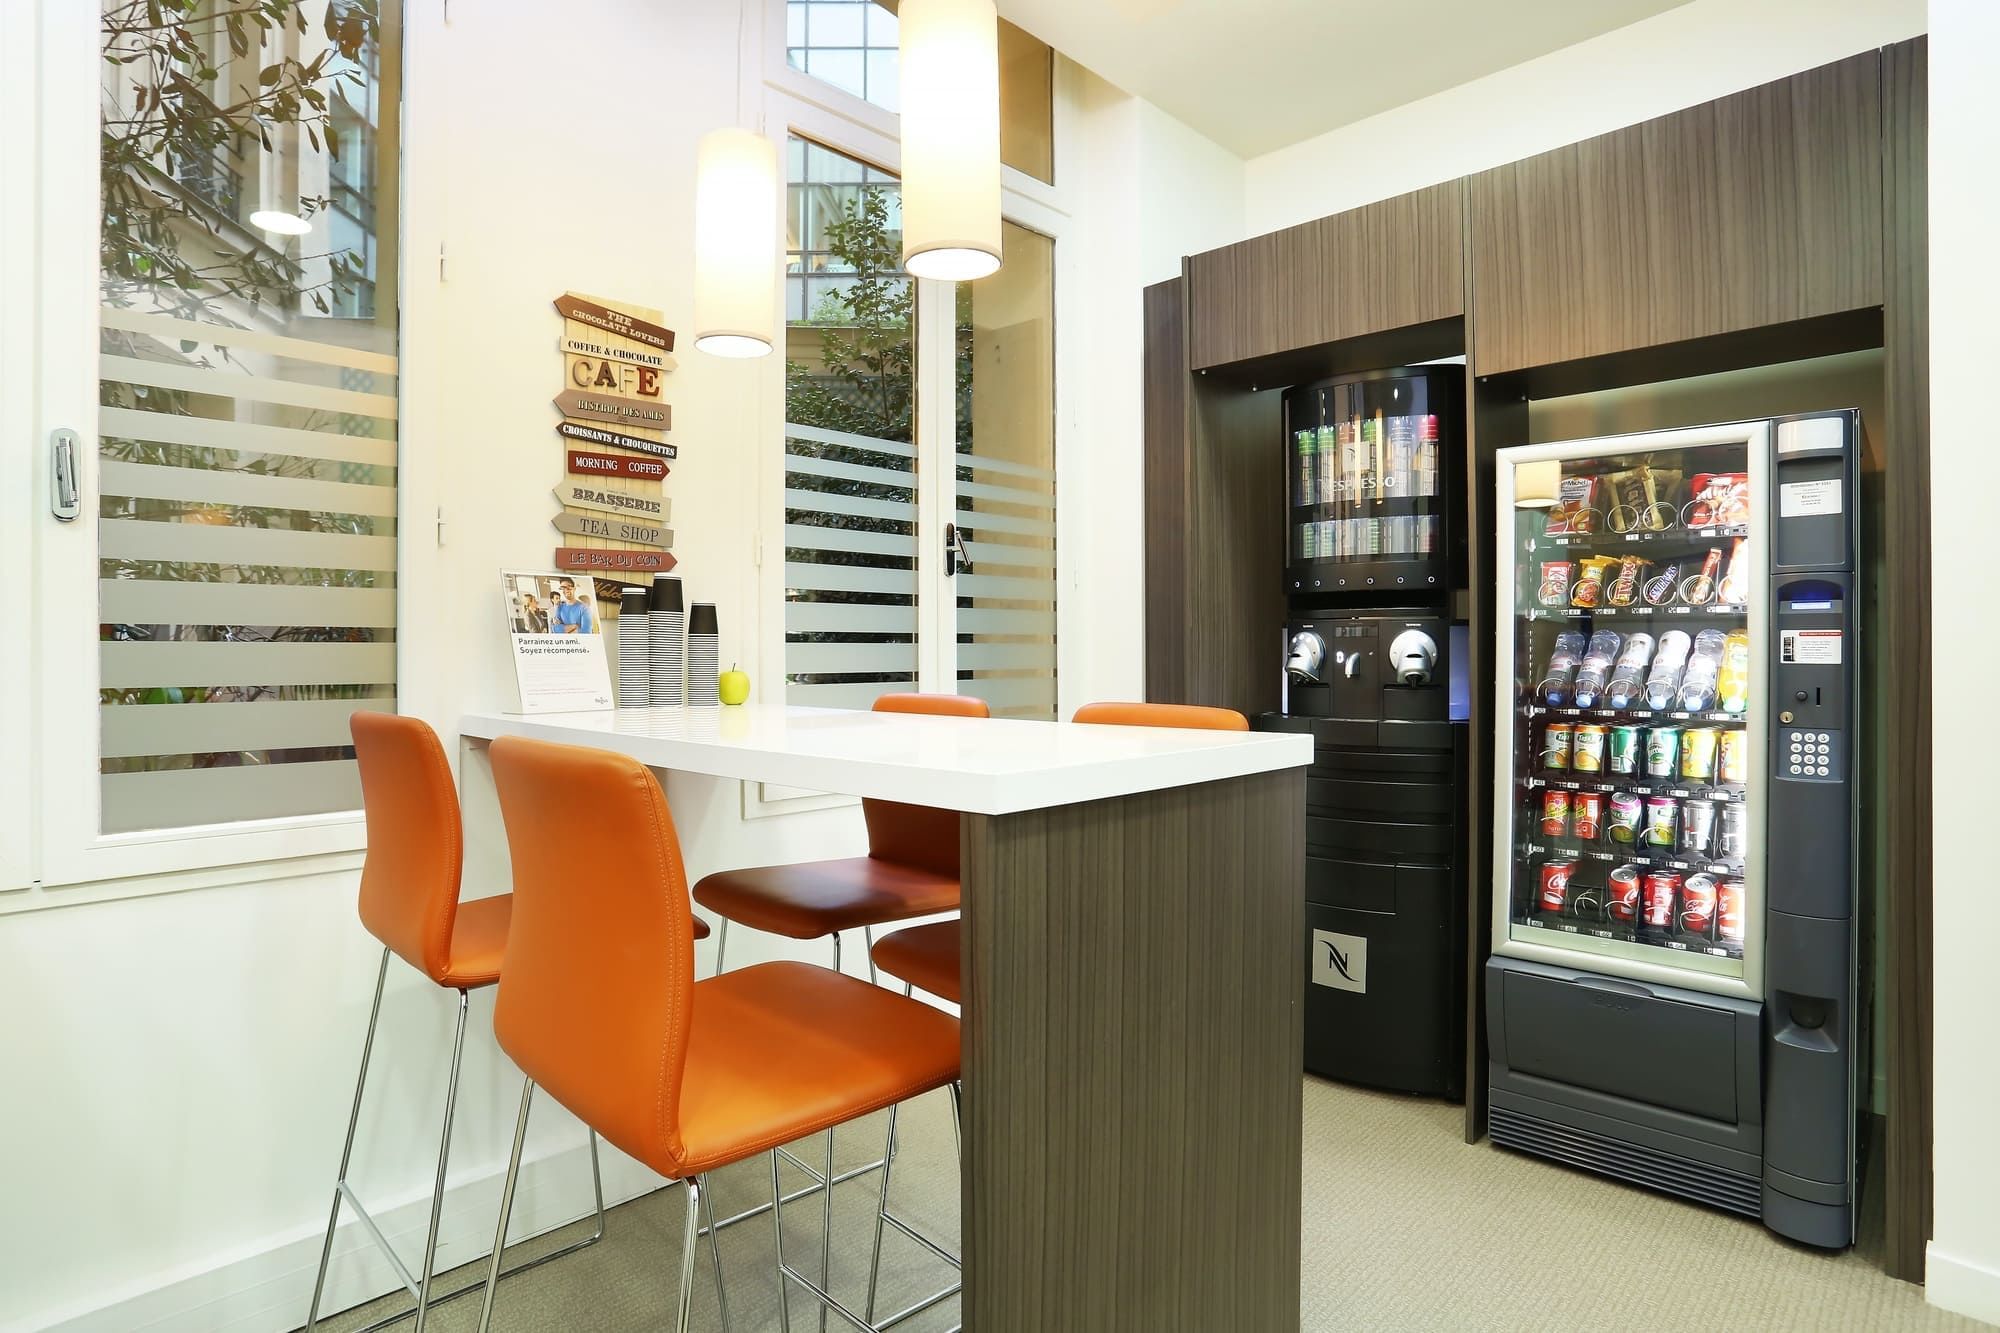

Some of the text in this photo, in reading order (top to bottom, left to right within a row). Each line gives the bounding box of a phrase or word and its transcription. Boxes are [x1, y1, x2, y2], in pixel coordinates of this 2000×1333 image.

[572, 309, 666, 347] CHOCOLATE LOVERS
[607, 311, 632, 327] THE
[568, 340, 663, 366] COFFEE & CHOCOLATE
[577, 399, 620, 415] BISTROT
[623, 406, 640, 418] DES
[642, 409, 665, 421] AMIS
[562, 424, 676, 457] CROISSANTS & CHOUQUETTES
[575, 456, 663, 475] MORNING COFFEE
[572, 487, 661, 514] BRASSERIE
[580, 518, 659, 543] TEA SHOP
[570, 553, 662, 568] LE BAR DU COIN
[519, 646, 542, 655] Soyez
